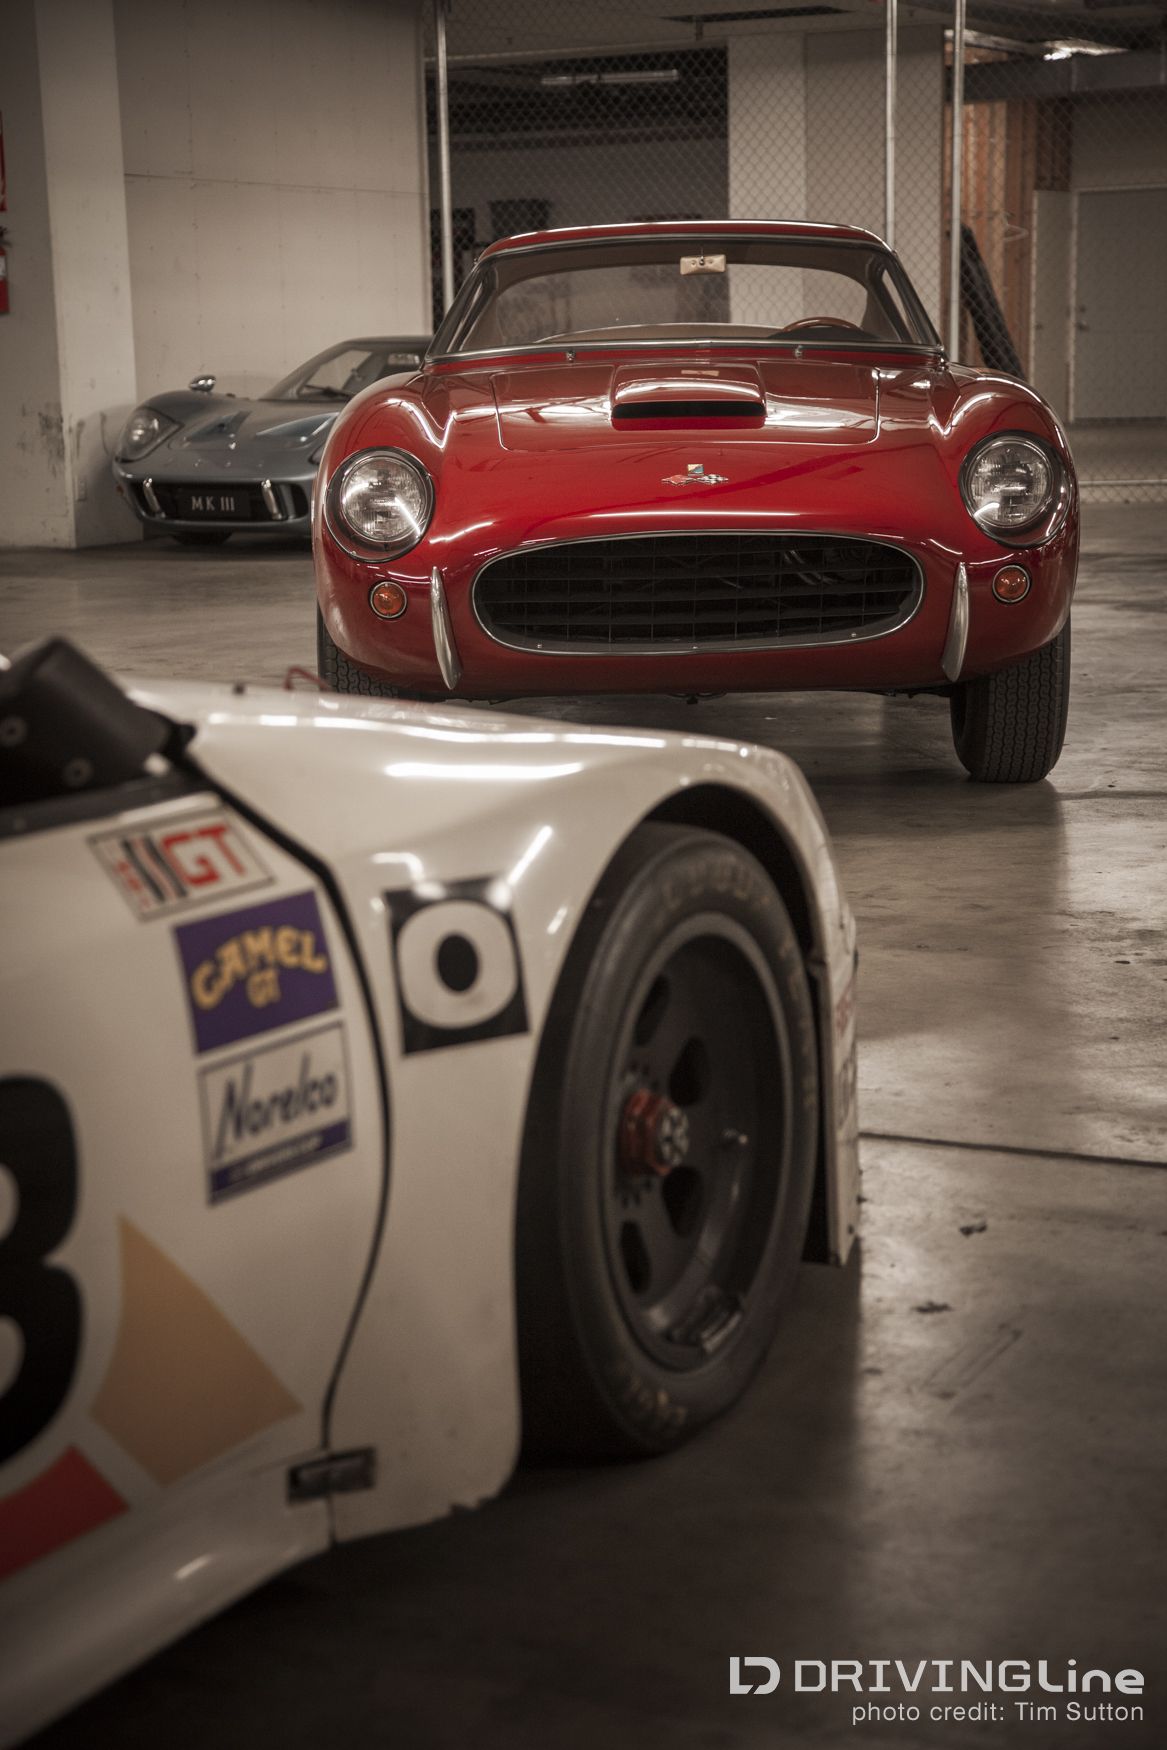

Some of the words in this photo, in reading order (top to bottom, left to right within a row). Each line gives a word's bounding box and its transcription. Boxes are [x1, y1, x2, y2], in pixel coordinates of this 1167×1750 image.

[191, 495, 215, 511] MK
[220, 495, 235, 512] III
[160, 822, 247, 887] GT
[191, 924, 328, 1010] CAMEL
[212, 1053, 340, 1163] Norelco
